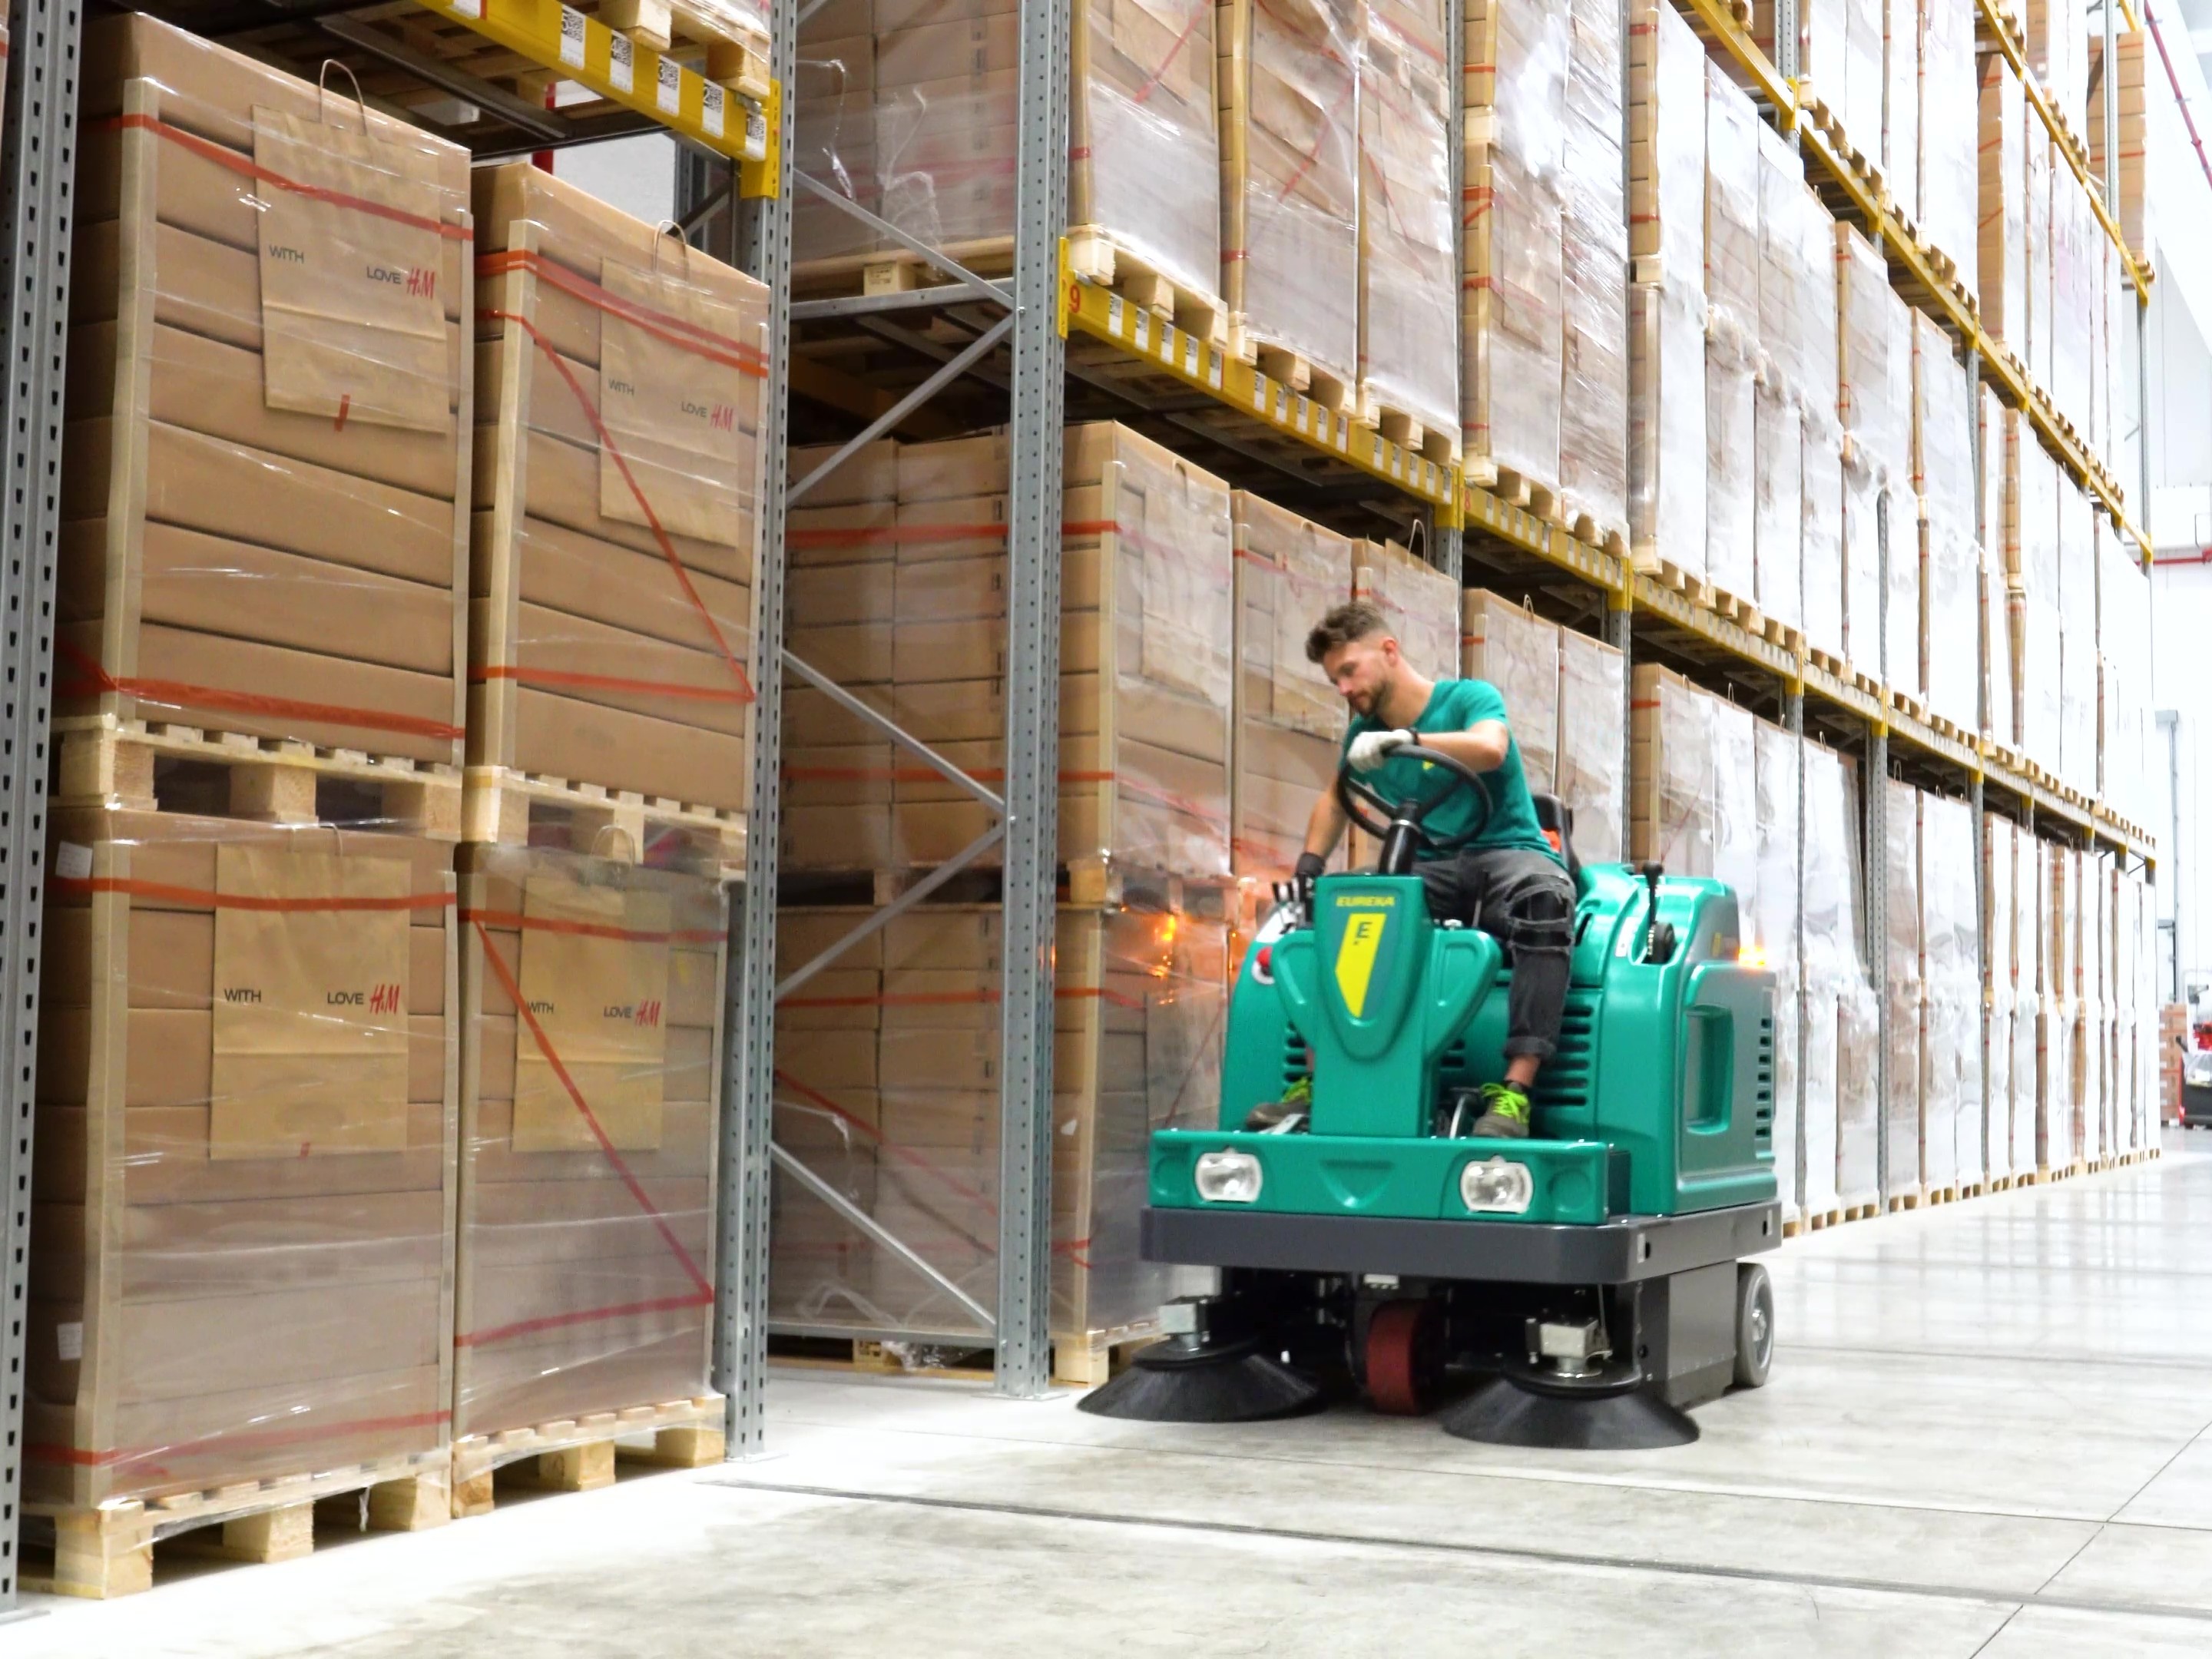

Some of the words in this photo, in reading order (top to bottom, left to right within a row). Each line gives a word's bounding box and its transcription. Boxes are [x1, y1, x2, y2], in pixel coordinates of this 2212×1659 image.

[269, 245, 305, 263] WITH
[366, 266, 402, 284] LOVE
[1070, 283, 1081, 313] 9
[608, 379, 635, 396] WITH
[681, 401, 707, 418] LOVE
[1356, 922, 1373, 939] E
[224, 988, 262, 1003] WITH
[327, 992, 364, 1005] LOVE
[527, 1001, 555, 1015] WITH
[604, 1005, 633, 1018] LOVE
